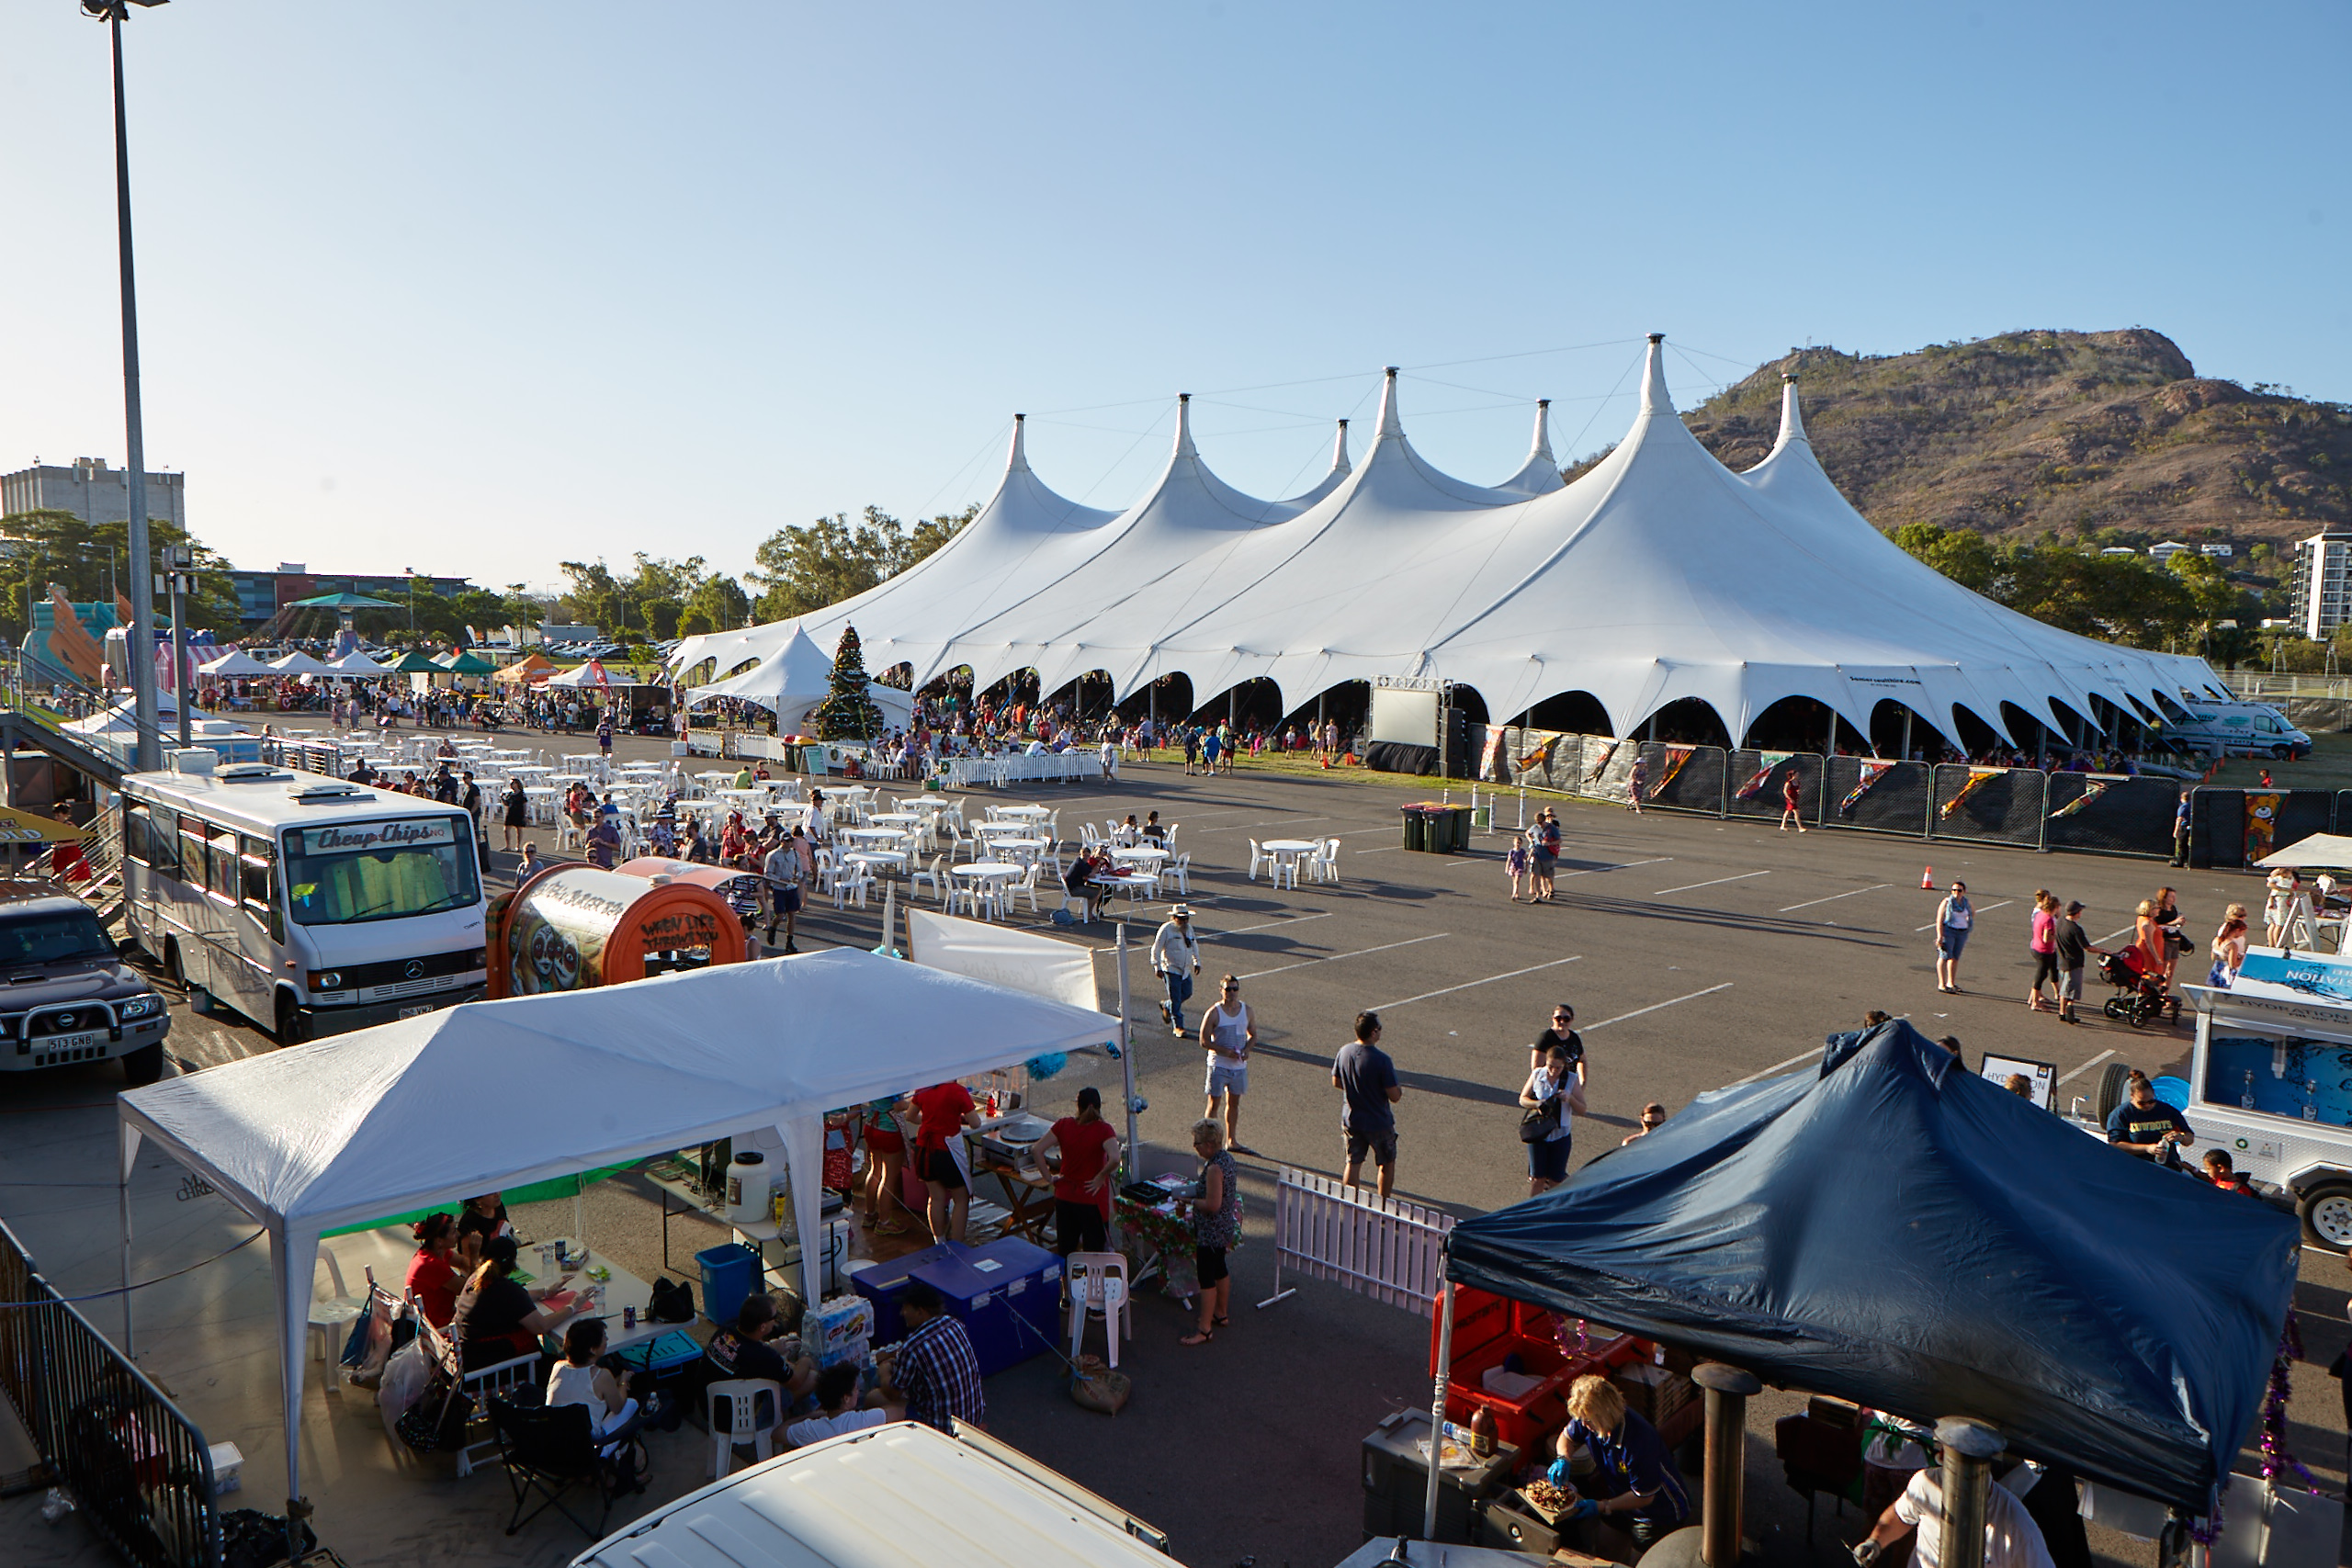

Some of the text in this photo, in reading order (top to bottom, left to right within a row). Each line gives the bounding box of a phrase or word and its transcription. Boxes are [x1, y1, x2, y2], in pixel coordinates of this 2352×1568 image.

[318, 829, 377, 848] Cheap
[380, 824, 432, 844] Chips
[430, 829, 445, 837] NQ
[640, 913, 716, 937] WHEN LIFE
[641, 931, 718, 950] THROWS YOU
[2240, 999, 2349, 1021] HYDRATION
[50, 1039, 69, 1049] 513
